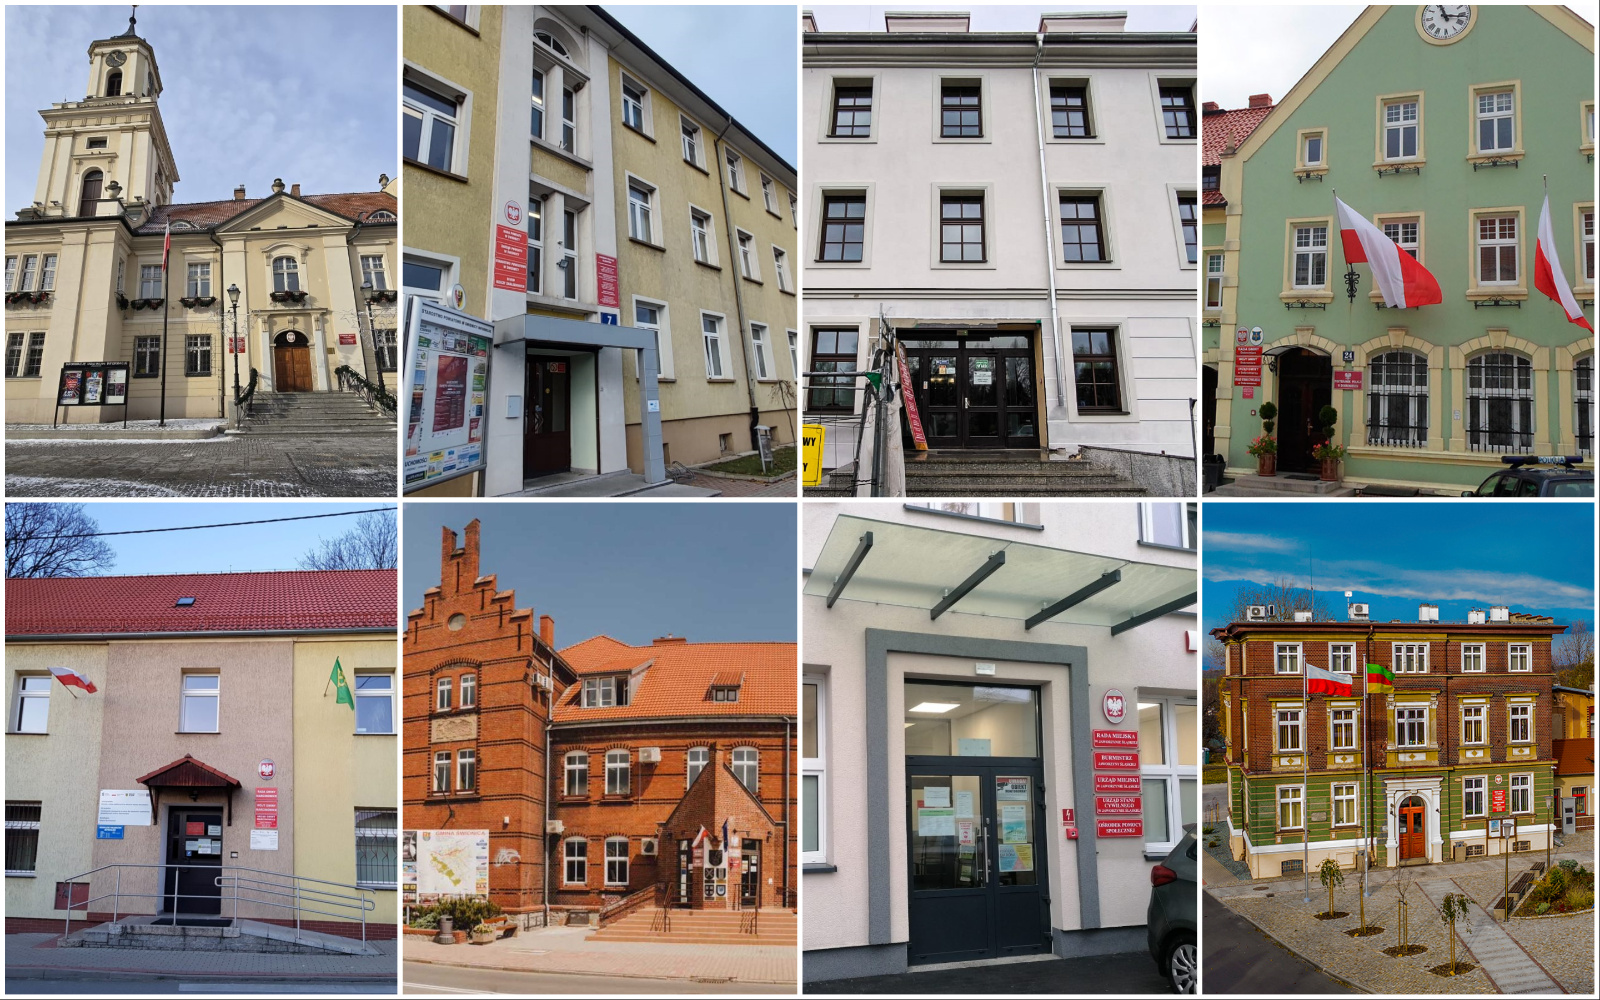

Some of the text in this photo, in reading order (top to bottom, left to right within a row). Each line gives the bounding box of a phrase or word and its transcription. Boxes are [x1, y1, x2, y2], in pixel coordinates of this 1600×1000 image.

[607, 316, 612, 325] 7
[803, 437, 816, 446] WY
[803, 463, 808, 472] Y
